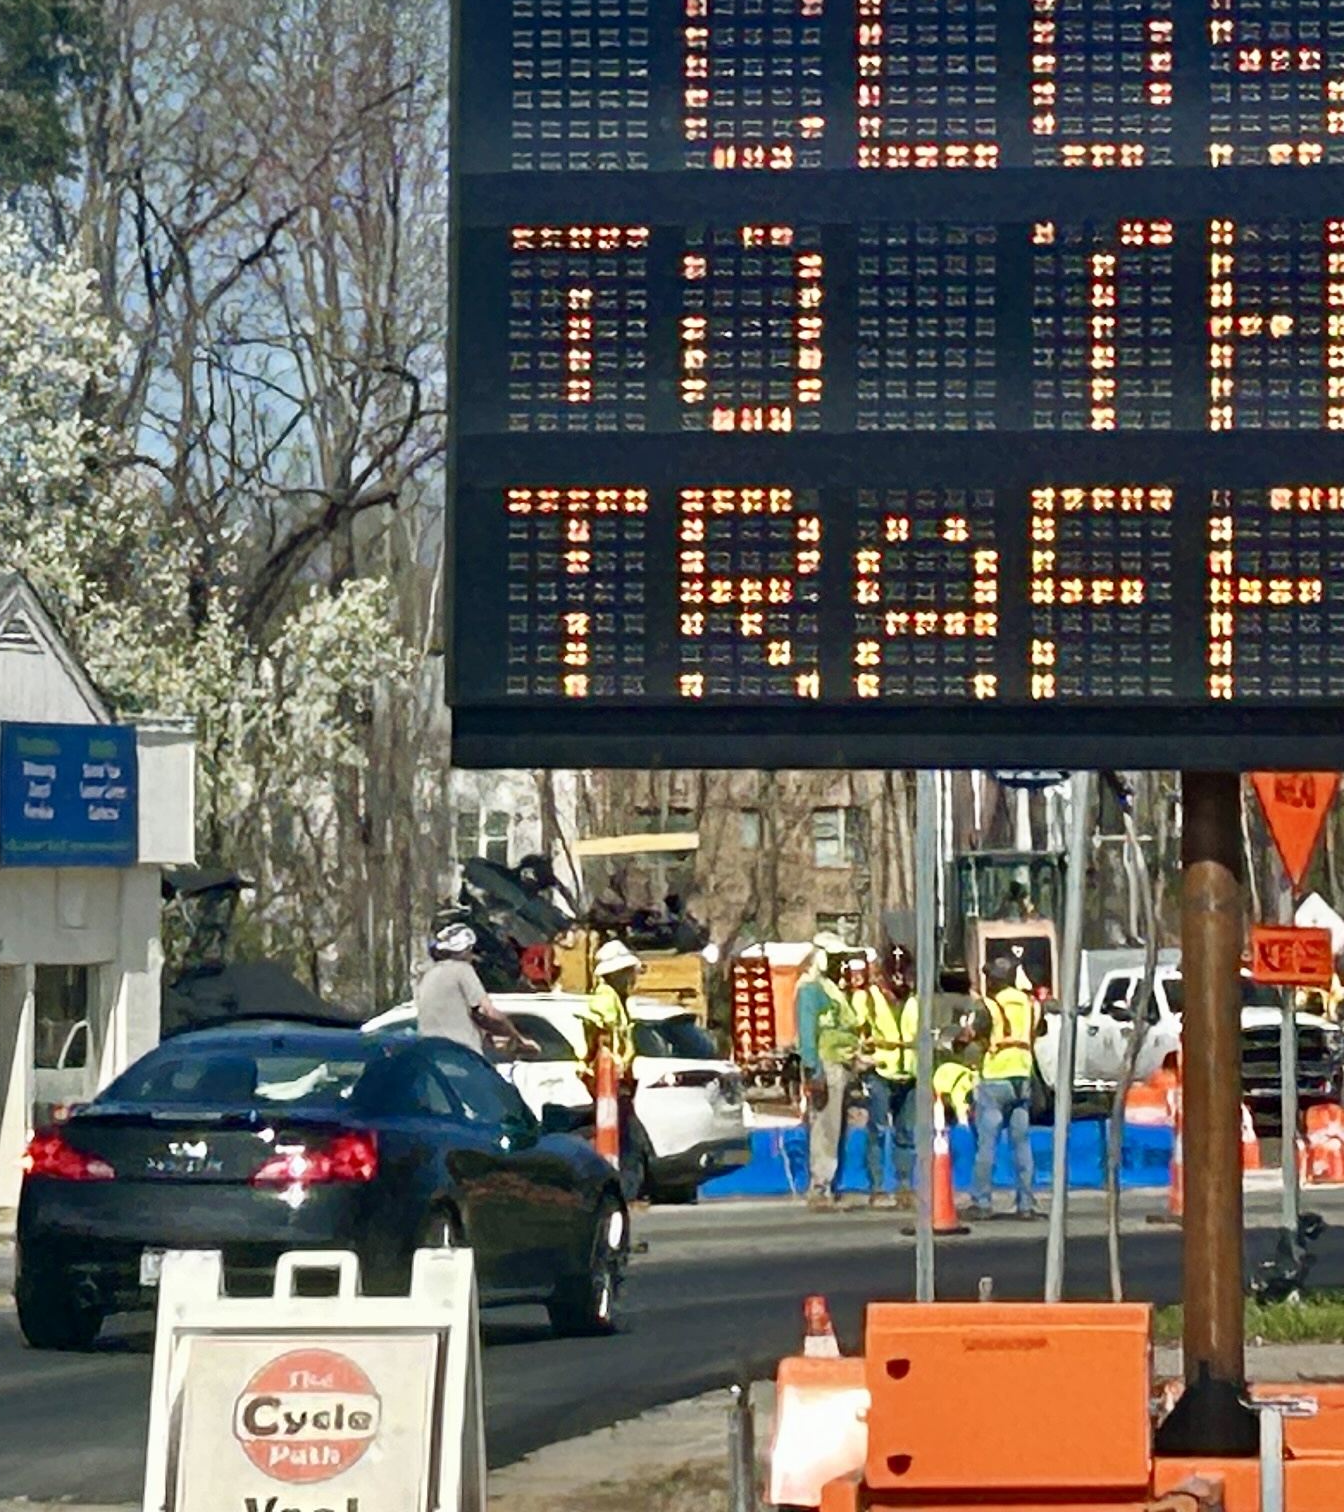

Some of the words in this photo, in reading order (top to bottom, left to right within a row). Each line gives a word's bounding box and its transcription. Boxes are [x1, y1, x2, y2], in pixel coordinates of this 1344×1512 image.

[510, 222, 823, 432] TO
[243, 1395, 373, 1437] Cycle
[269, 1444, 342, 1469] Path
